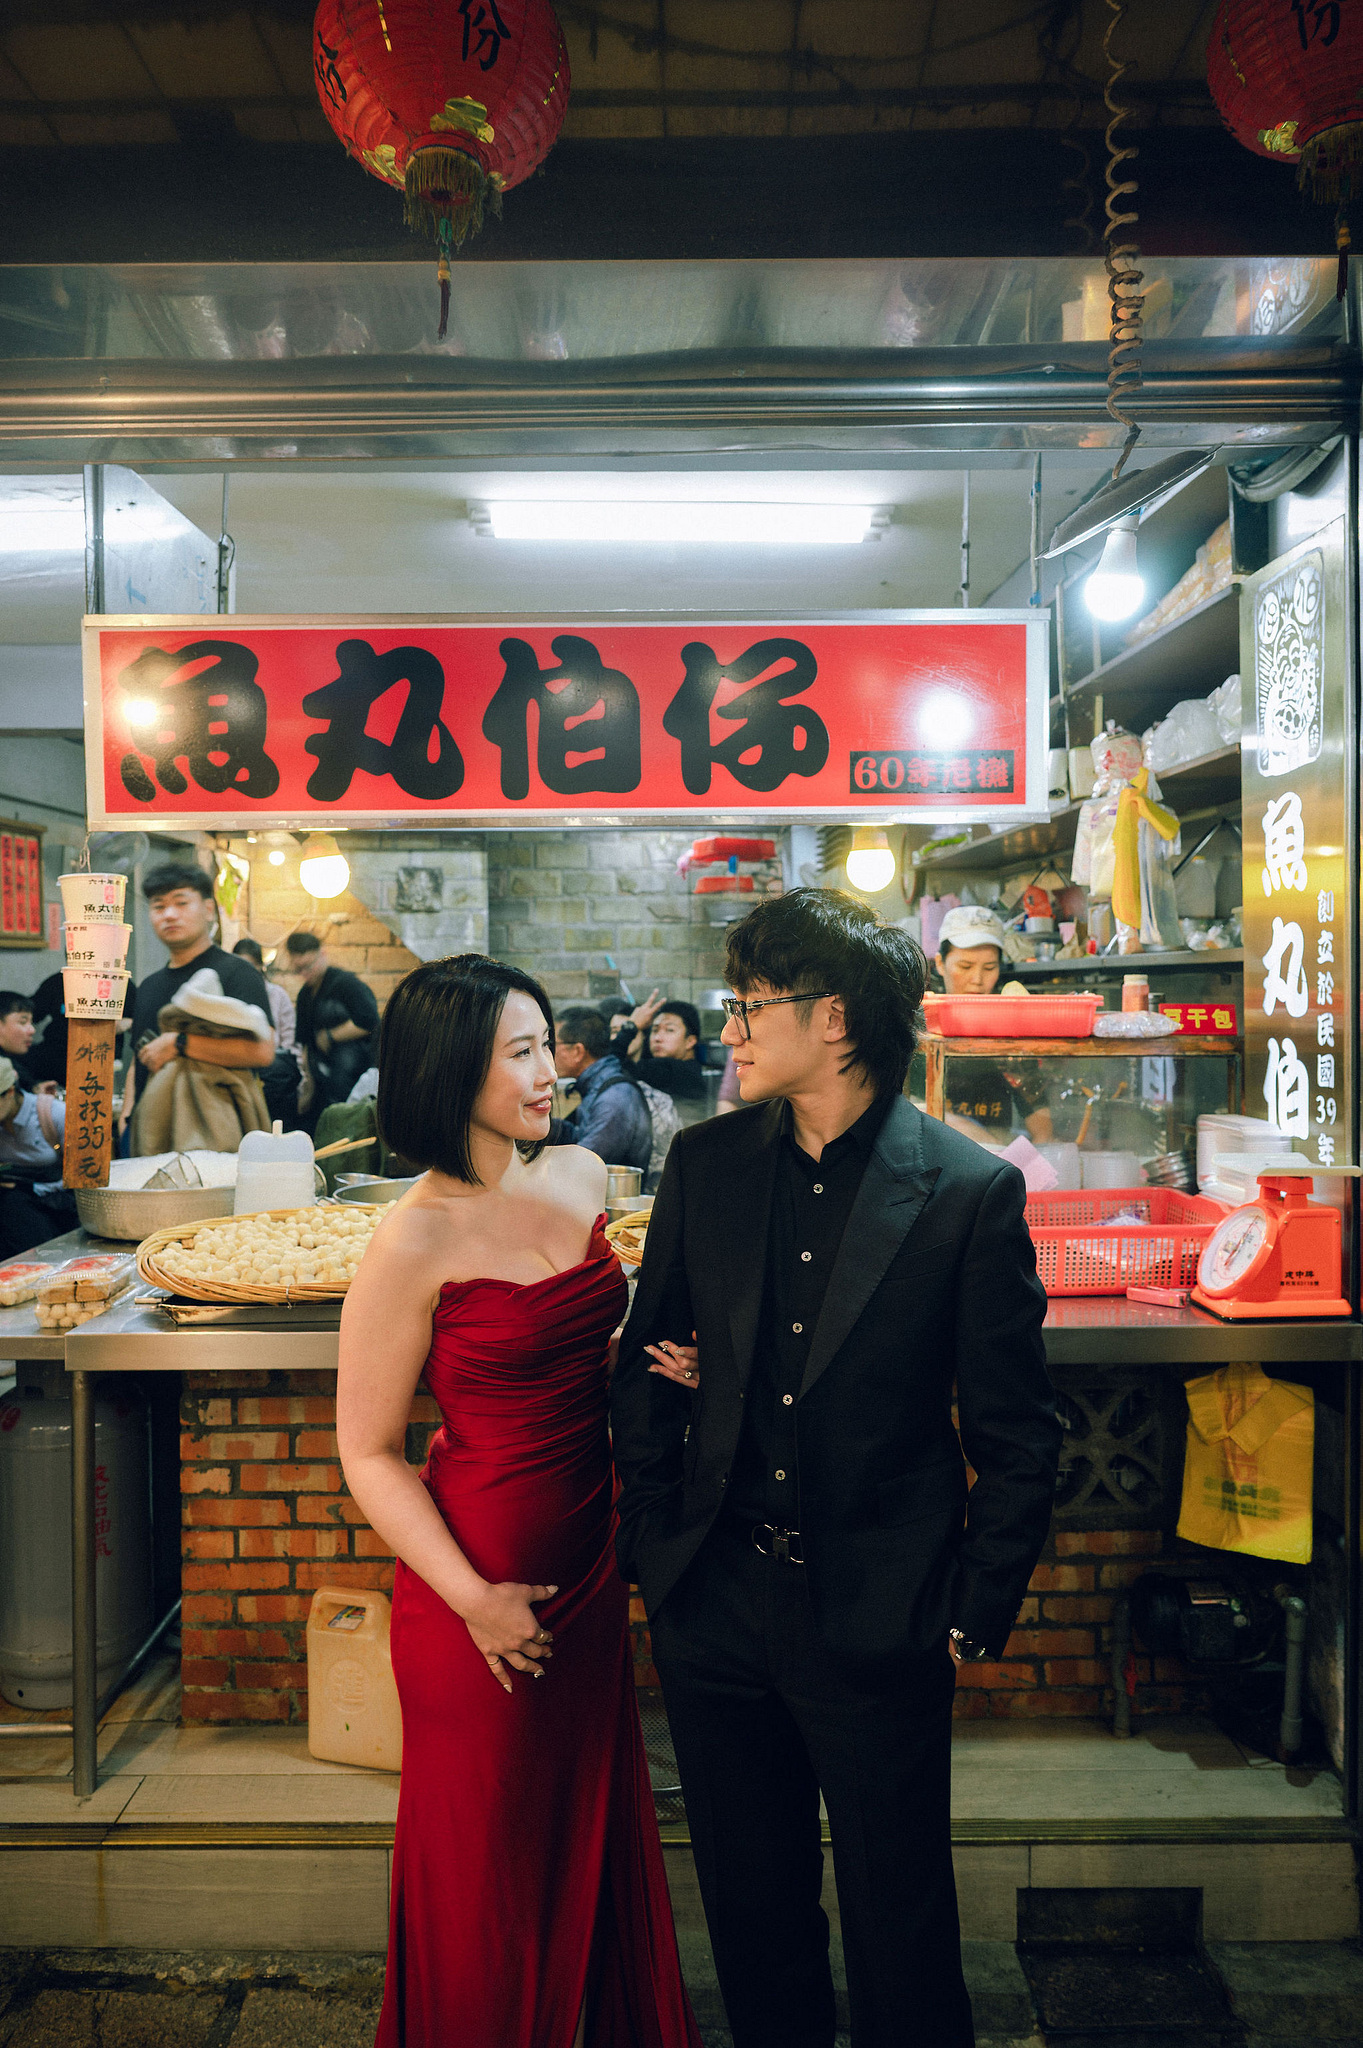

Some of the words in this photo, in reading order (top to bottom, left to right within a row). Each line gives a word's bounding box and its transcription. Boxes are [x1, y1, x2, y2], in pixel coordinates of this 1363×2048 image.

[119, 635, 830, 802] 魚丸伯仔
[75, 1042, 112, 1066] 外帶
